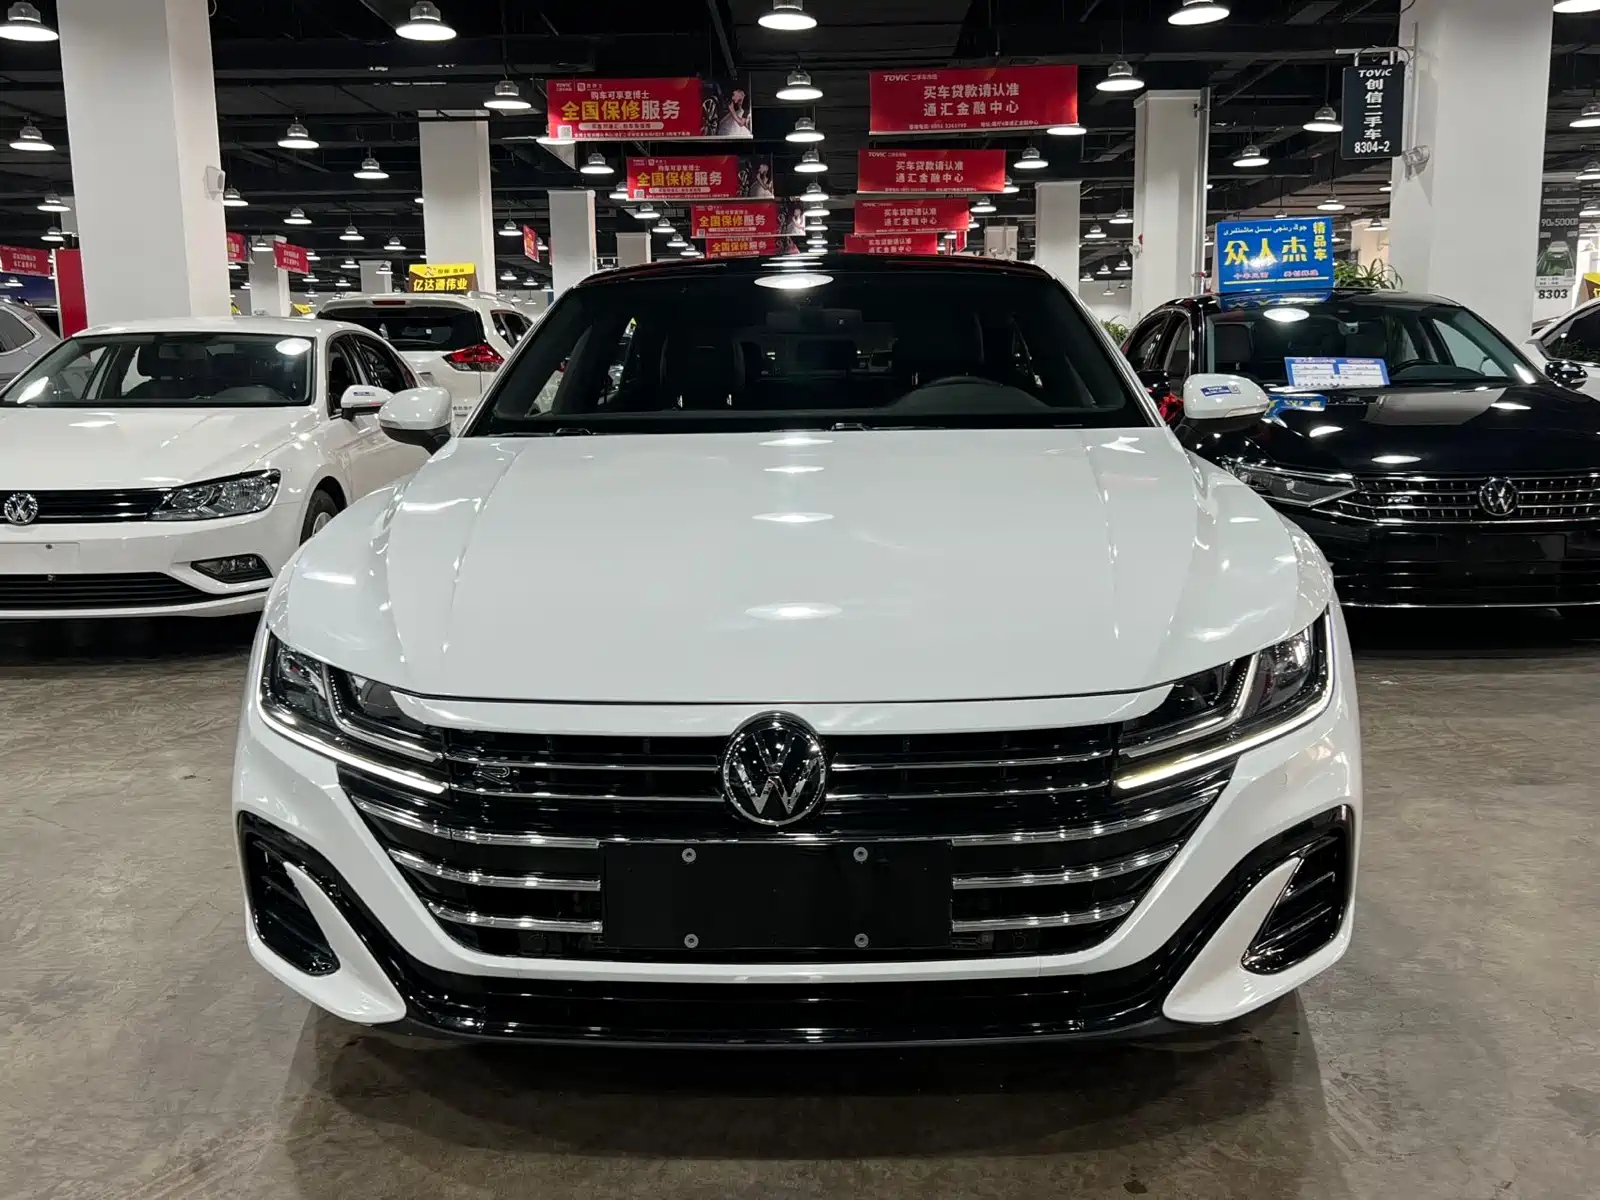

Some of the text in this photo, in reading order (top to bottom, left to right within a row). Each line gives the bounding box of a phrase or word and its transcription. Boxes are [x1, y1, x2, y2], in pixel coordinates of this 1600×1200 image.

[883, 74, 910, 82] TOVIC
[1358, 69, 1392, 77] TOVIC
[591, 91, 650, 100] 购车可享查博士
[924, 83, 1020, 100] 买车贷款请认准
[561, 100, 681, 121] 全国保修服务
[924, 101, 1019, 117] 通汇金融中心
[1364, 79, 1384, 140] 创信二手车
[1354, 141, 1390, 153] 8304-2
[896, 160, 964, 171] 买车贷款请认准
[637, 171, 722, 186] 全国保修服务
[896, 173, 964, 183] 通汇金融中心
[700, 215, 765, 227] 全国保修服务
[1313, 221, 1328, 261] 精品车
[1223, 236, 1308, 266] 众人杰
[1538, 289, 1568, 300] 8303
